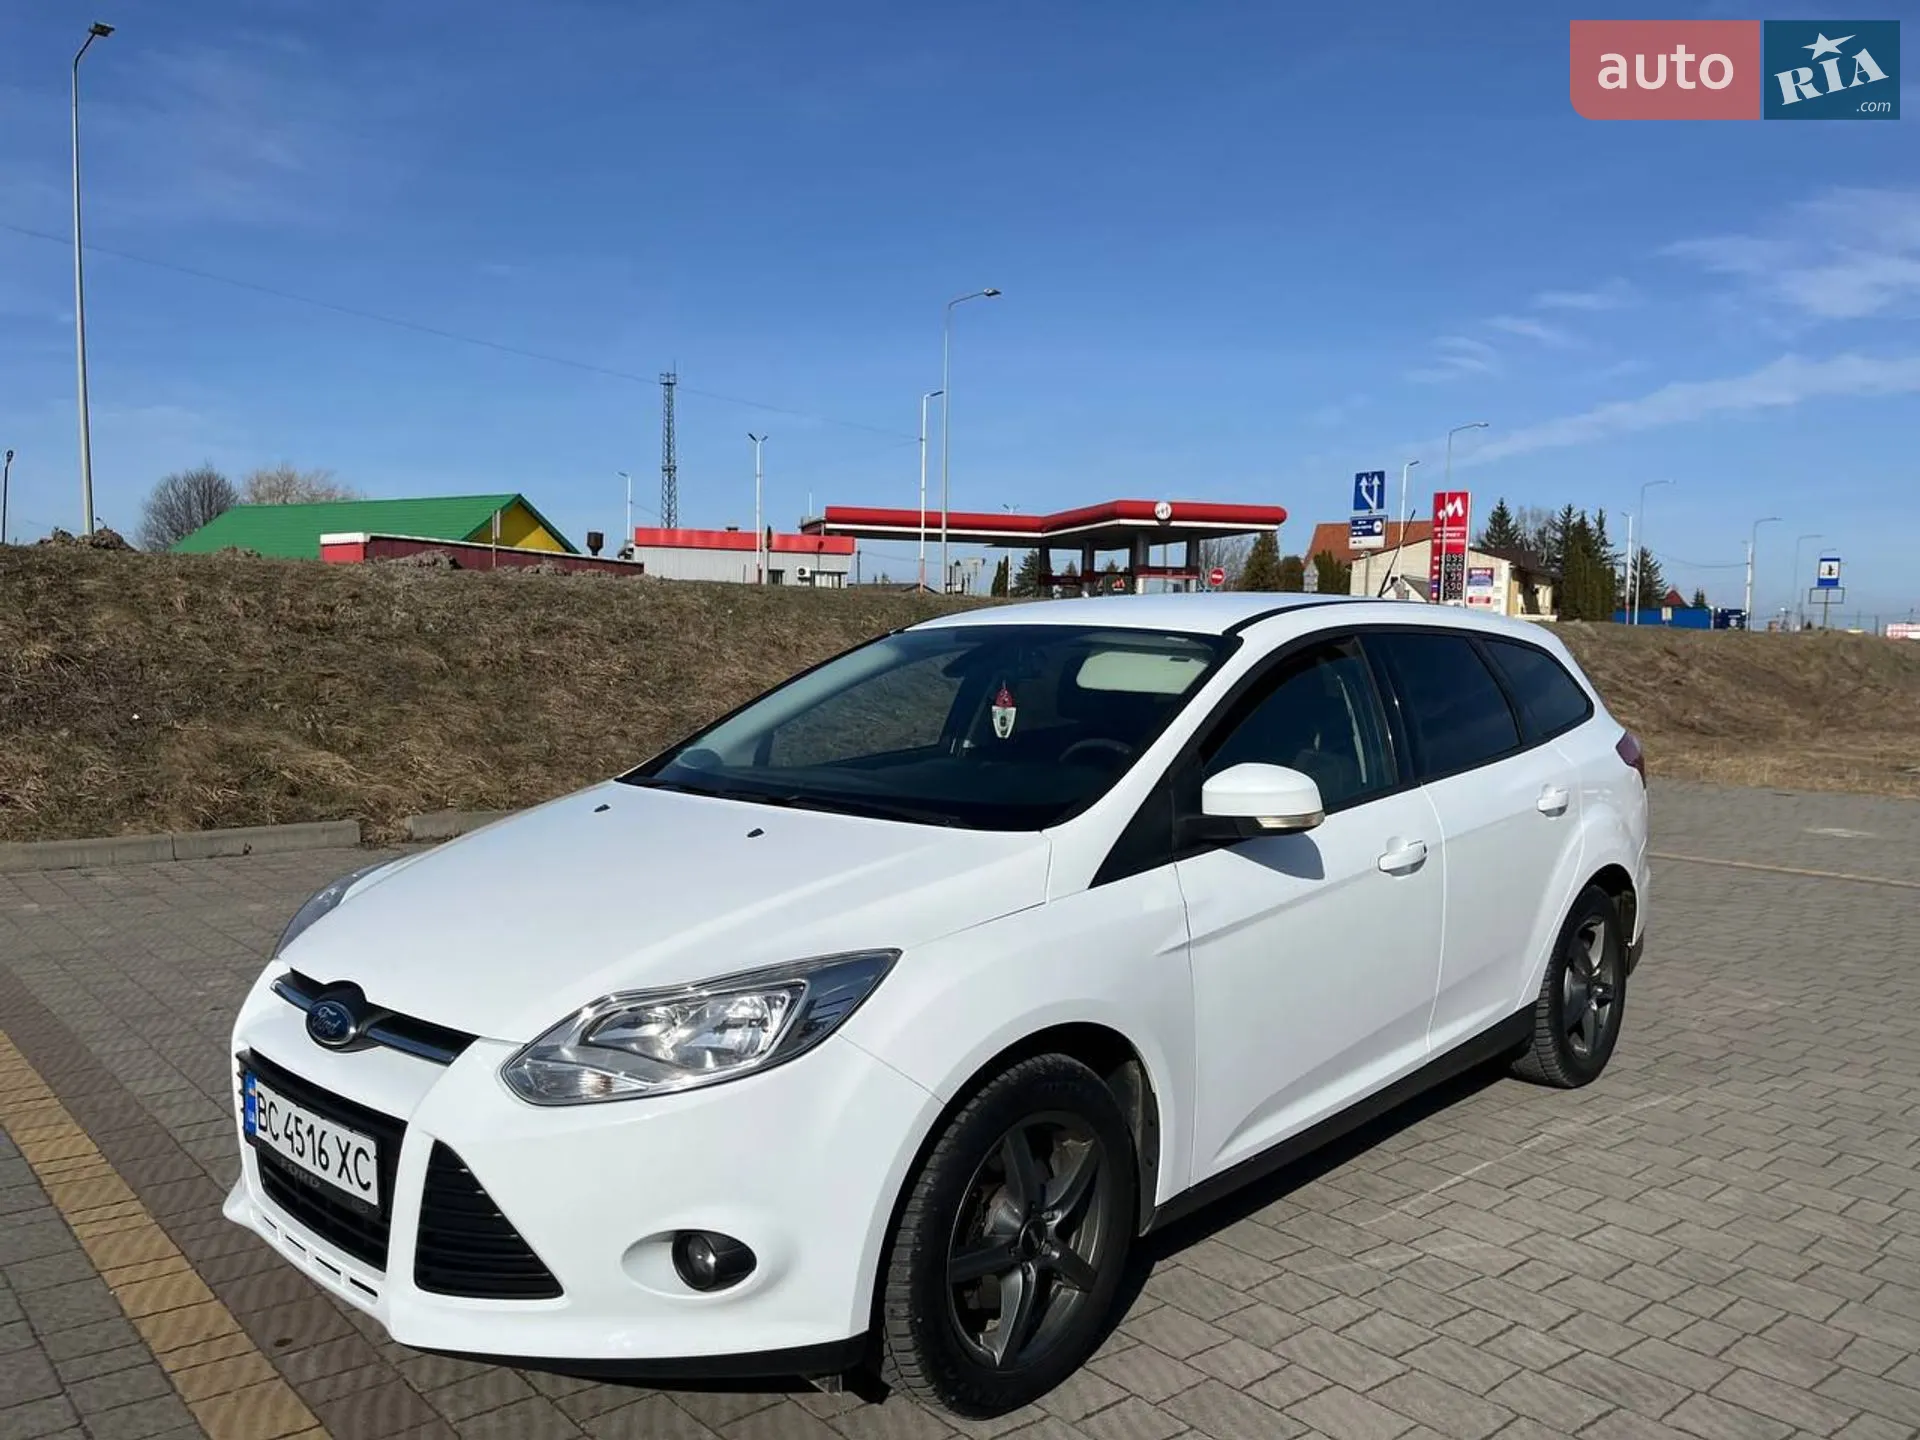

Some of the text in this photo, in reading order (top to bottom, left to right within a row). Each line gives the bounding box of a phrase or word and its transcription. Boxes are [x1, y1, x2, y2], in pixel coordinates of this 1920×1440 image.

[312, 1006, 341, 1036] Ford
[257, 1091, 372, 1191] BC 4516 XC
